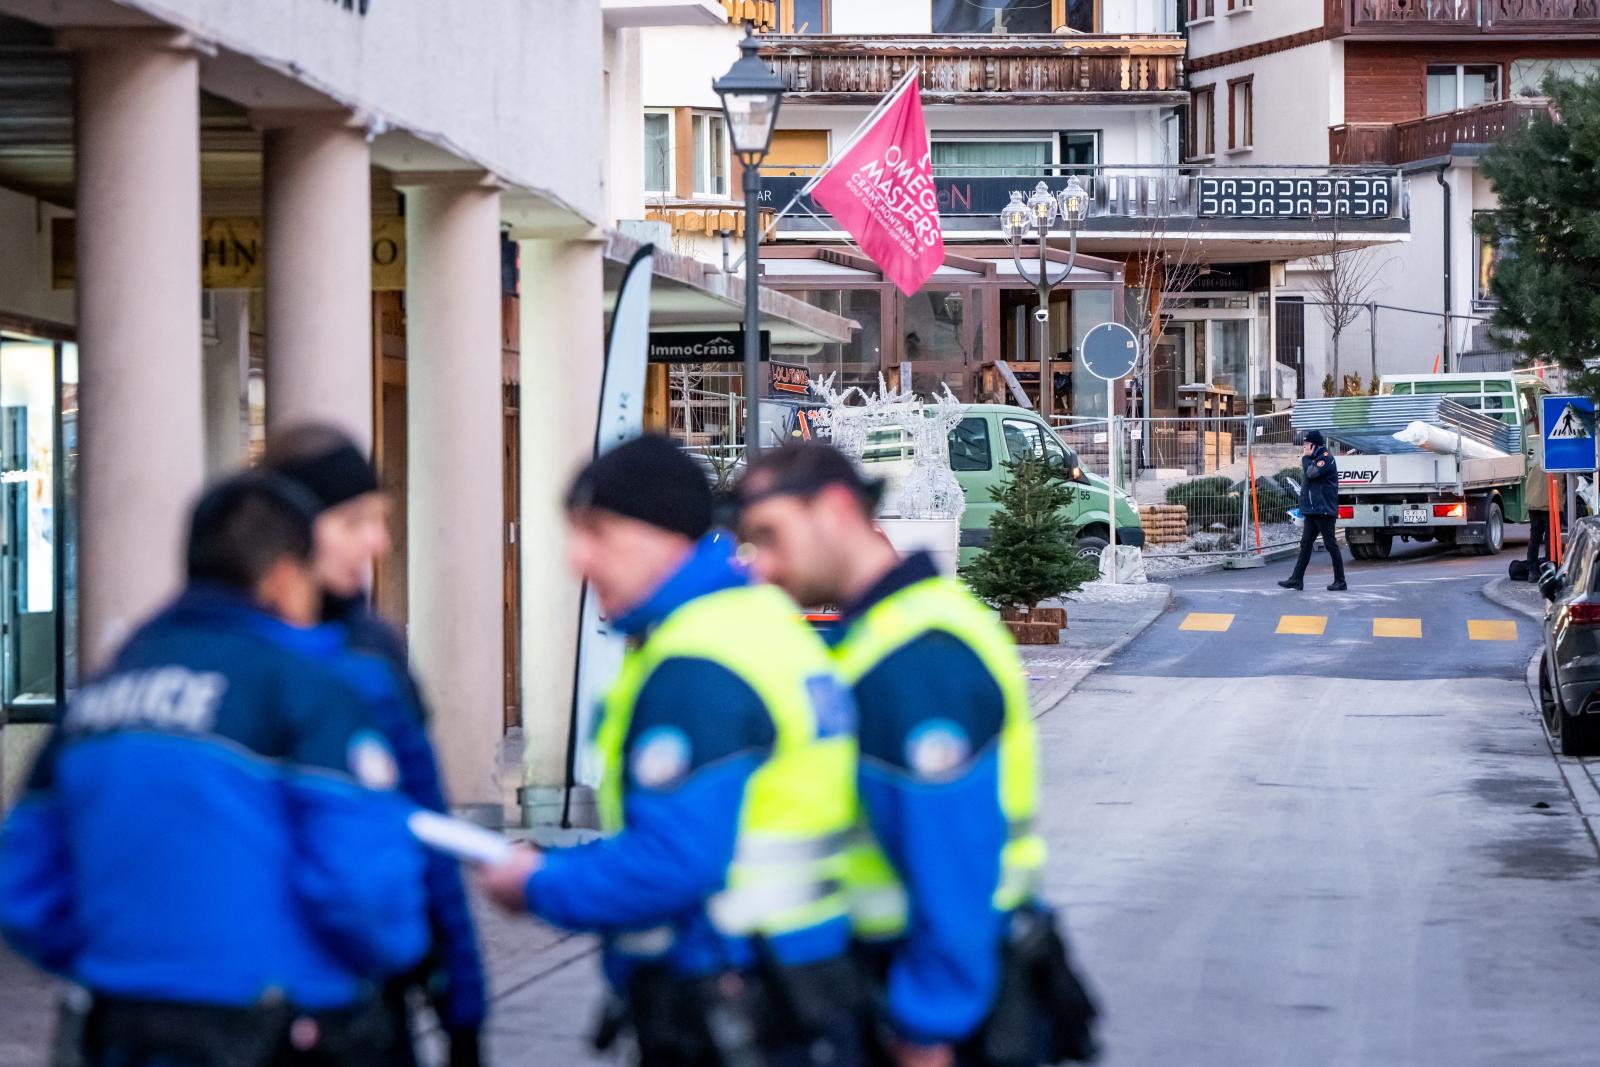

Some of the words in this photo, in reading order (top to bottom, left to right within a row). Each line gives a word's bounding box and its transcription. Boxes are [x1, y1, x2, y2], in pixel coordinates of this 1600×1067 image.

[851, 173, 881, 205] CRANS
[879, 204, 917, 247] MONTANA
[860, 159, 940, 246] MASTERS
[884, 145, 941, 230] OMEGA
[650, 344, 736, 355] ImmoCrans
[1080, 491, 1091, 500] 55
